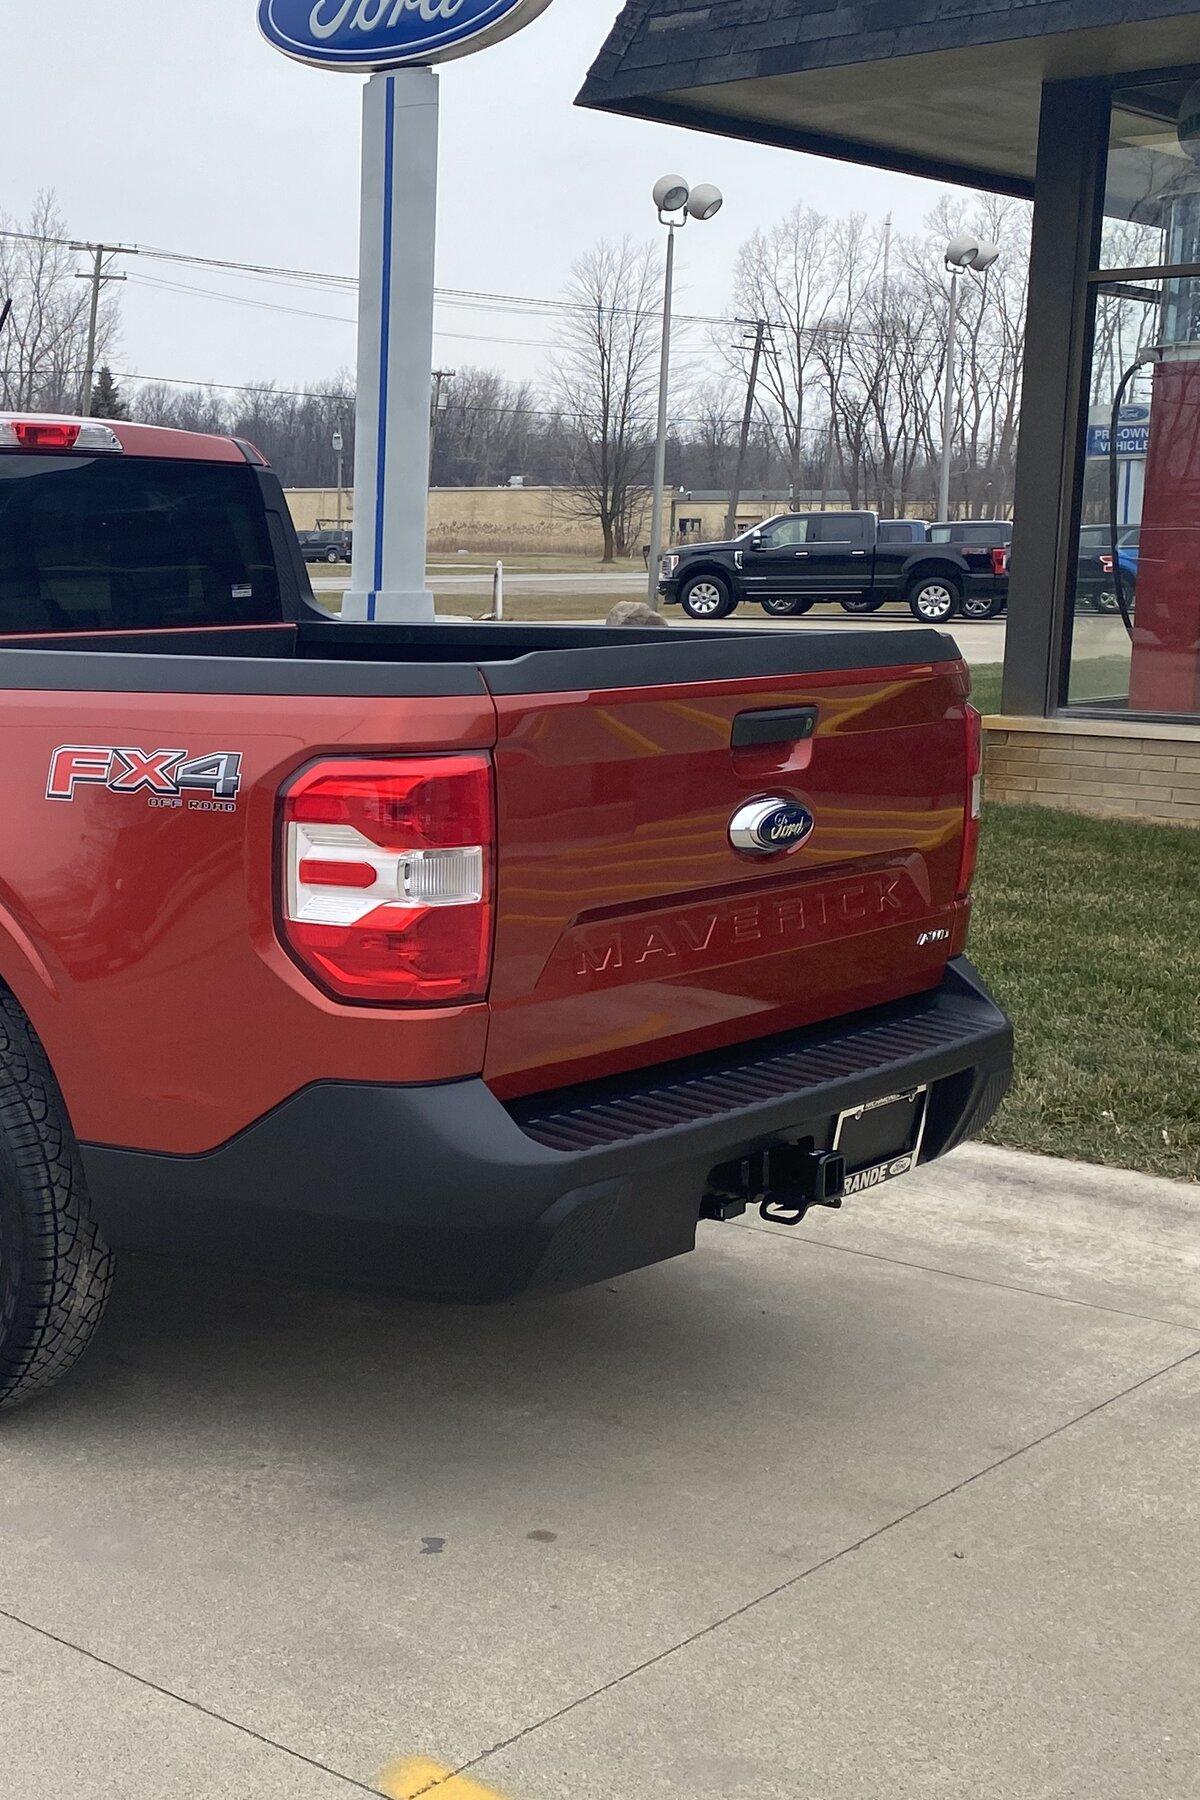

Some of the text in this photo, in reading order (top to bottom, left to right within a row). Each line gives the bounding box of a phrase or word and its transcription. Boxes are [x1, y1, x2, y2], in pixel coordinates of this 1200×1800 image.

[45, 744, 243, 801] FX4
[148, 798, 236, 812] OFF ROAD
[771, 811, 805, 840] Ford
[574, 878, 902, 974] MAVERICK
